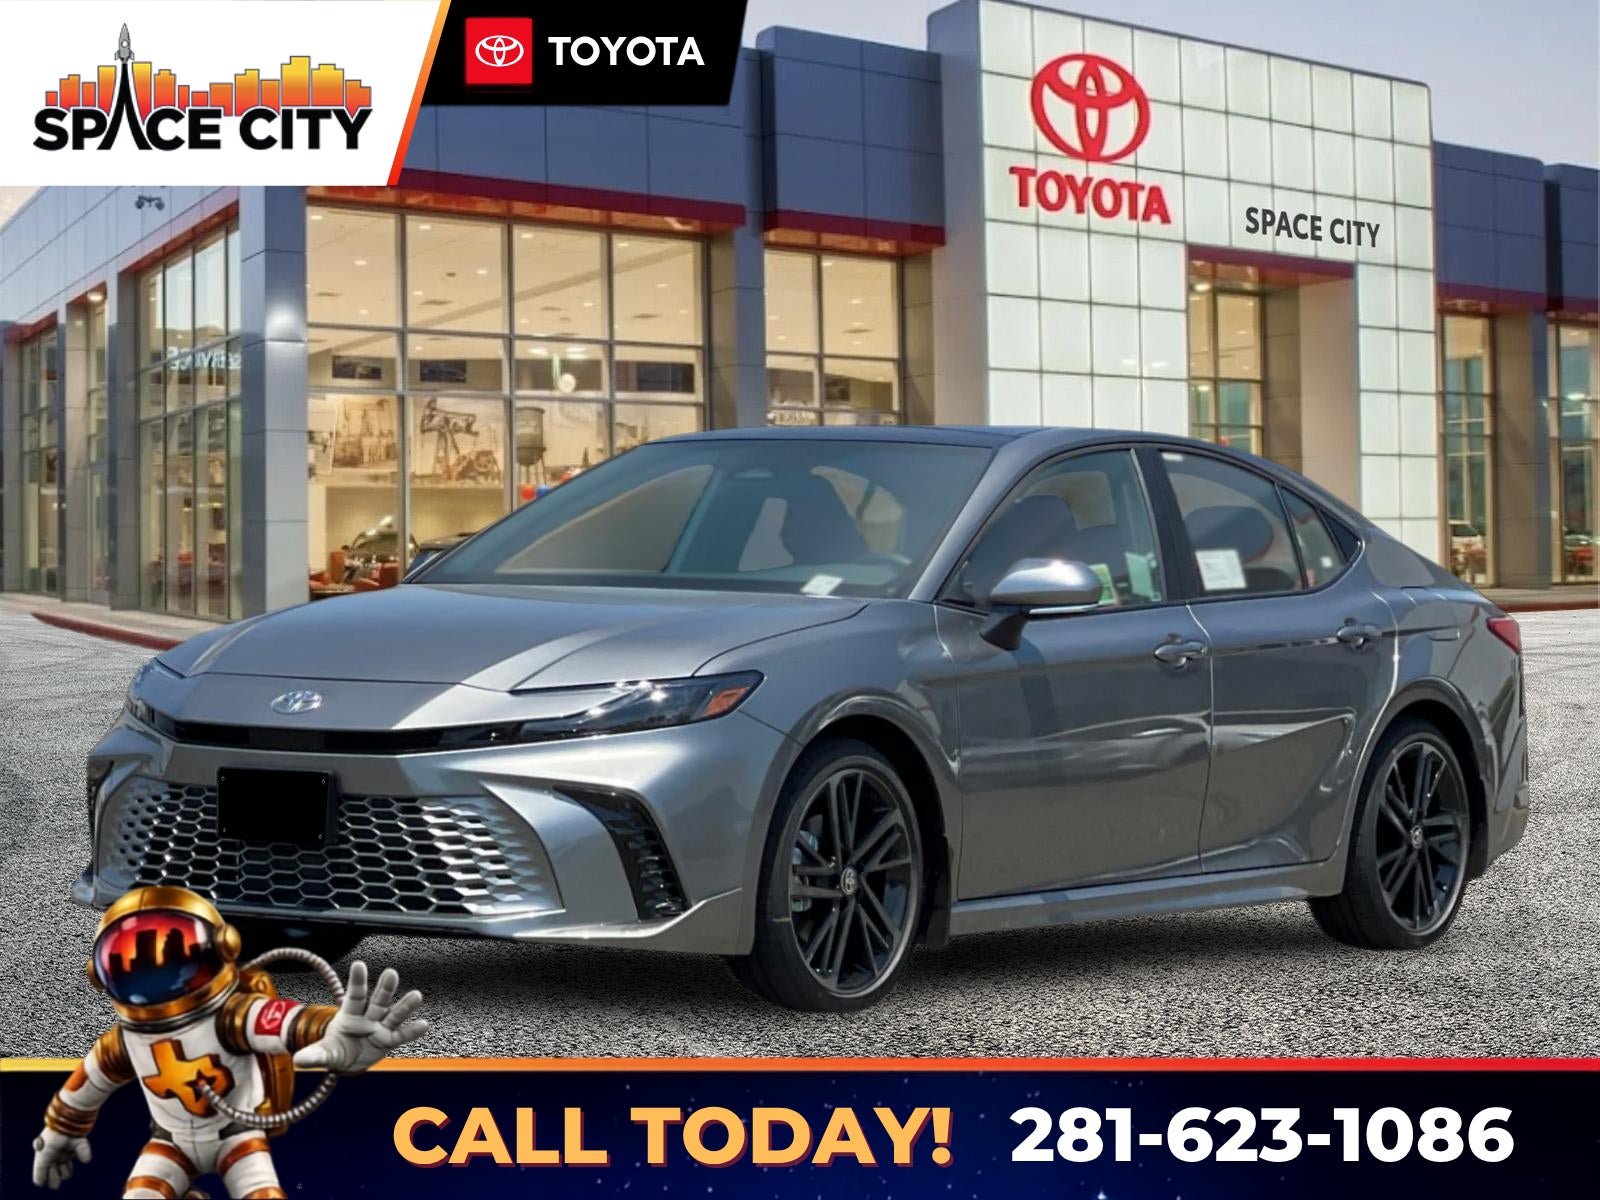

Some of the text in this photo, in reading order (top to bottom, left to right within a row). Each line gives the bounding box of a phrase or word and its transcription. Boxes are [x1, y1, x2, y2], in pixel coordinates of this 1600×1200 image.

[1009, 166, 1171, 224] TOYOTA
[1245, 206, 1380, 248] SPACE CITY
